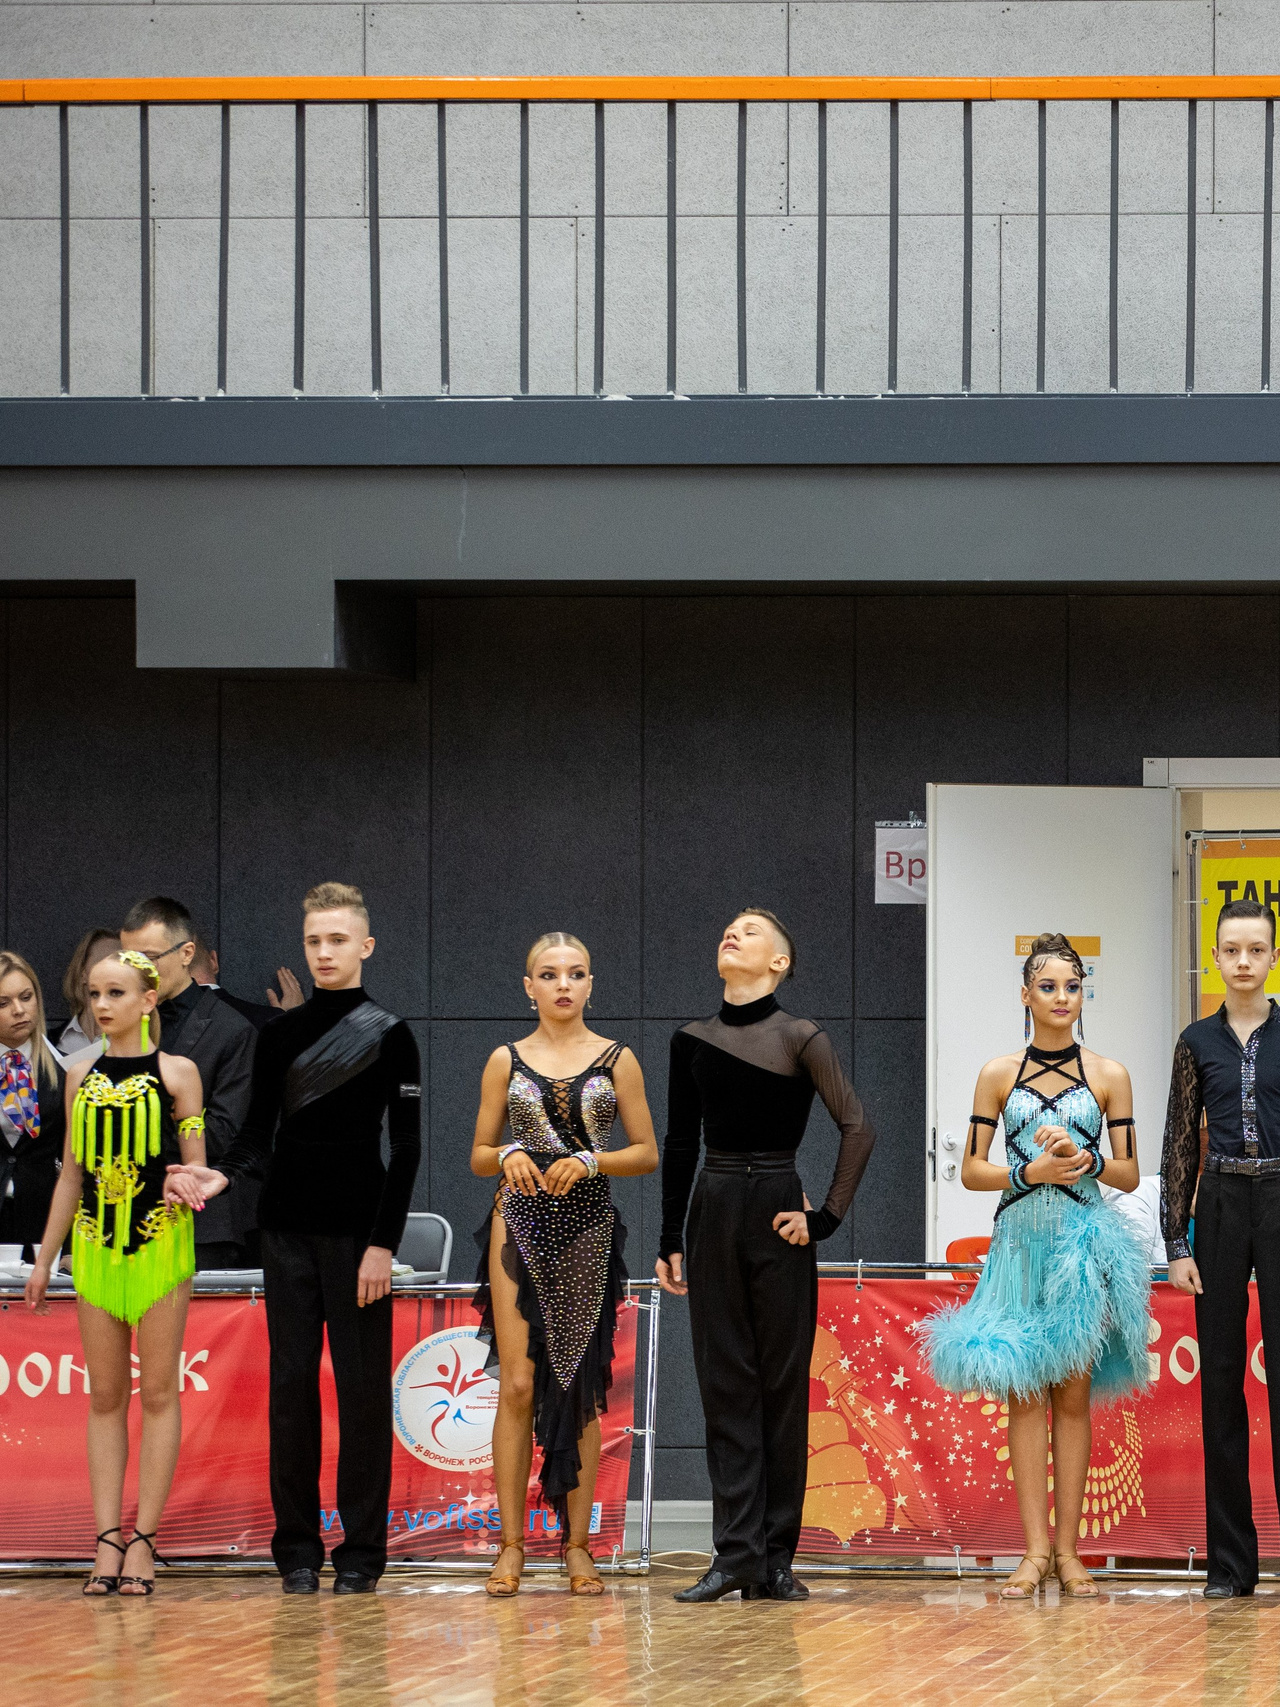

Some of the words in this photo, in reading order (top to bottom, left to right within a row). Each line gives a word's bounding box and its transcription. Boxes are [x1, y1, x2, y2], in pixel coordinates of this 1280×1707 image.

[396, 1343, 432, 1387] ОБЛАСТНАЯ
[393, 1387, 416, 1446] ВОРОНЕЖСКАЯ
[423, 1449, 465, 1466] ВОРОНЕЖ
